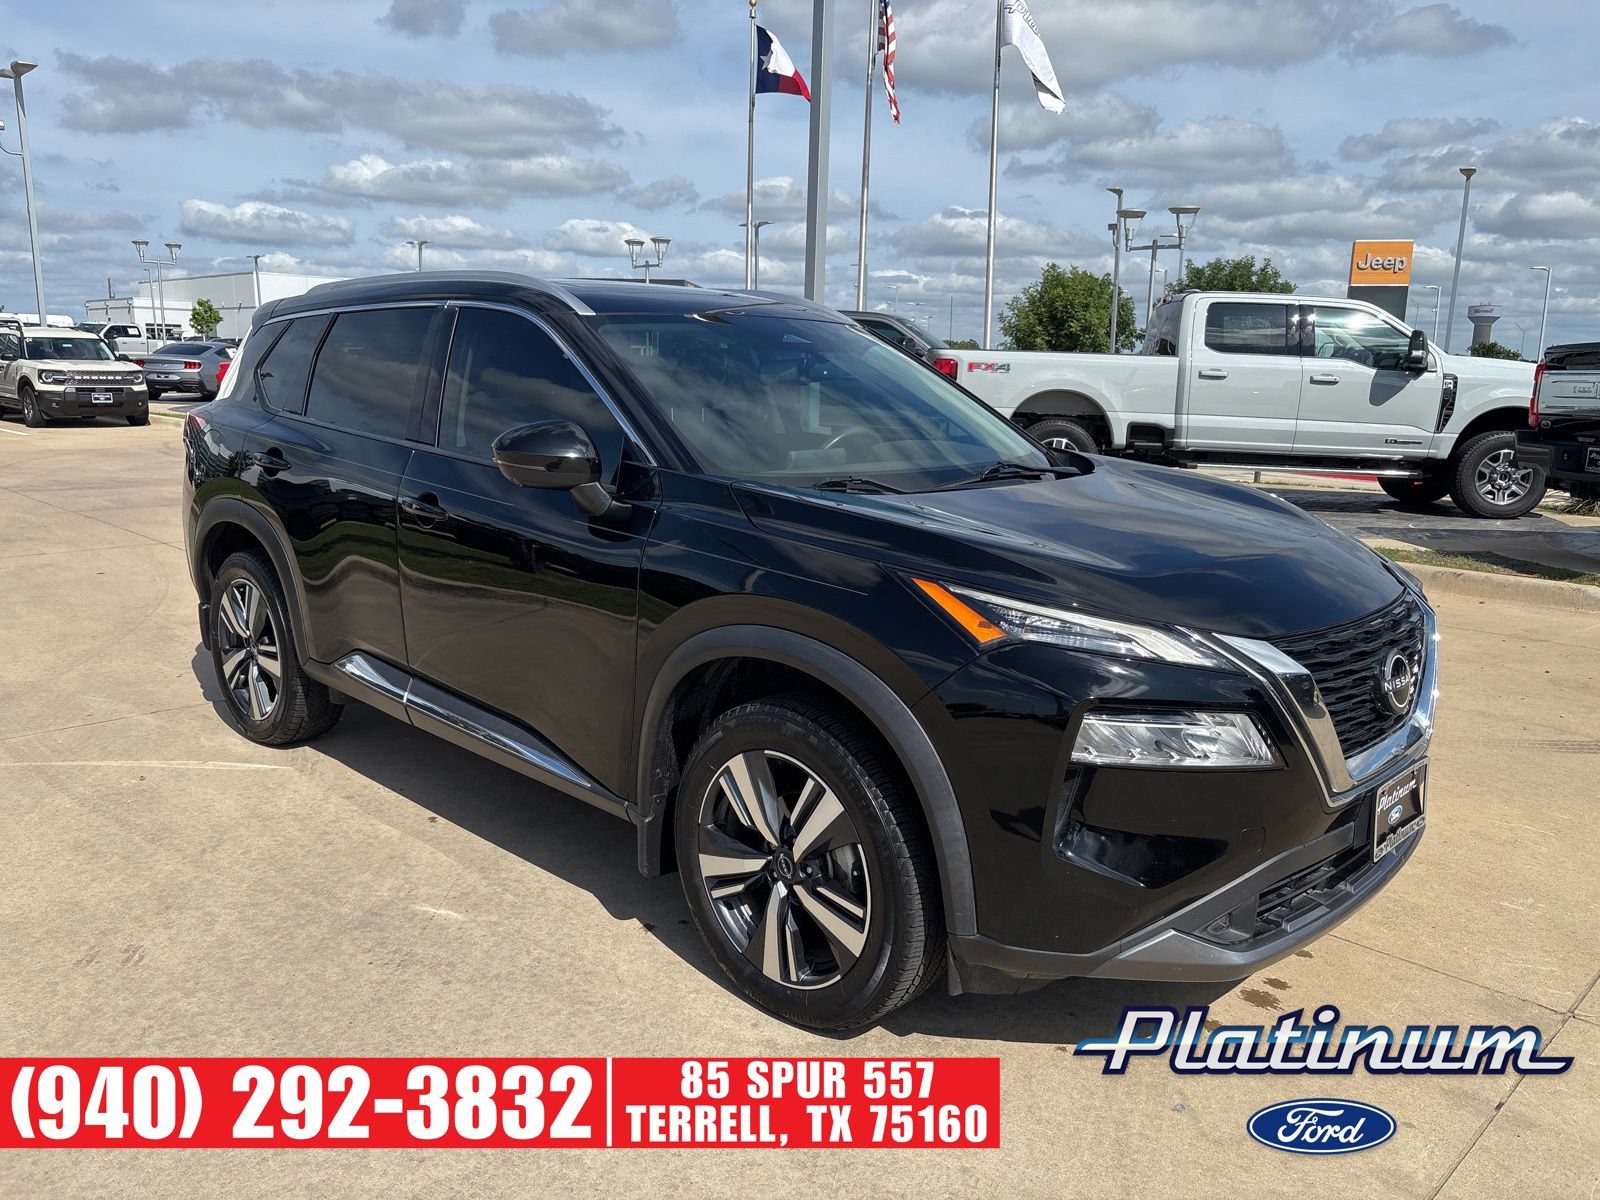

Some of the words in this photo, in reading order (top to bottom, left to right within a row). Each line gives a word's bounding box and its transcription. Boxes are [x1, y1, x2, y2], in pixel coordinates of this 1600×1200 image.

[1357, 253, 1408, 273] Jeep
[967, 362, 1010, 373] FX4
[1384, 674, 1409, 691] NISSA
[1377, 779, 1417, 815] Platinum
